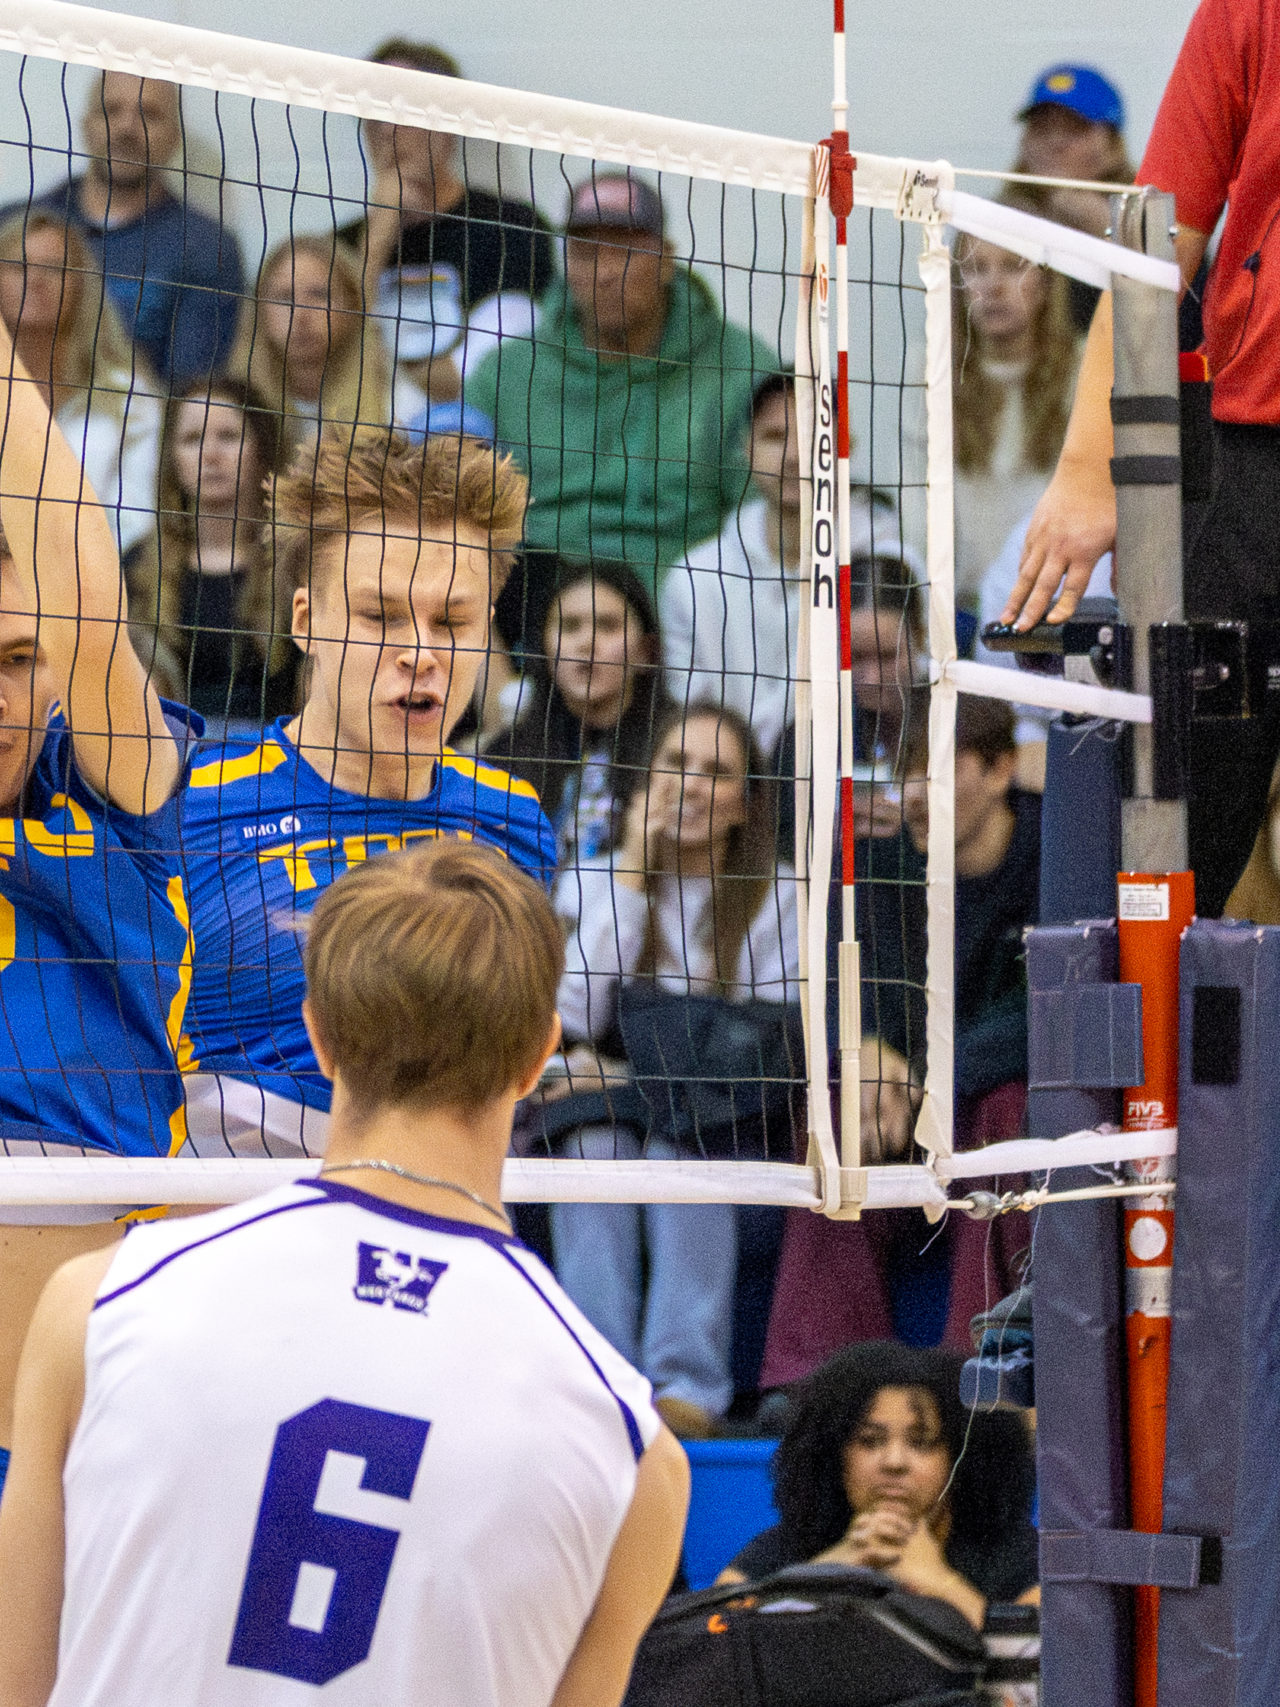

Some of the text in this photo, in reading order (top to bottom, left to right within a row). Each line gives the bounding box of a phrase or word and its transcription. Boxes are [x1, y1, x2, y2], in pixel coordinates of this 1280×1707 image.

[242, 822, 278, 839] BMO
[1128, 1101, 1164, 1117] FIVB
[227, 1396, 433, 1687] 6
